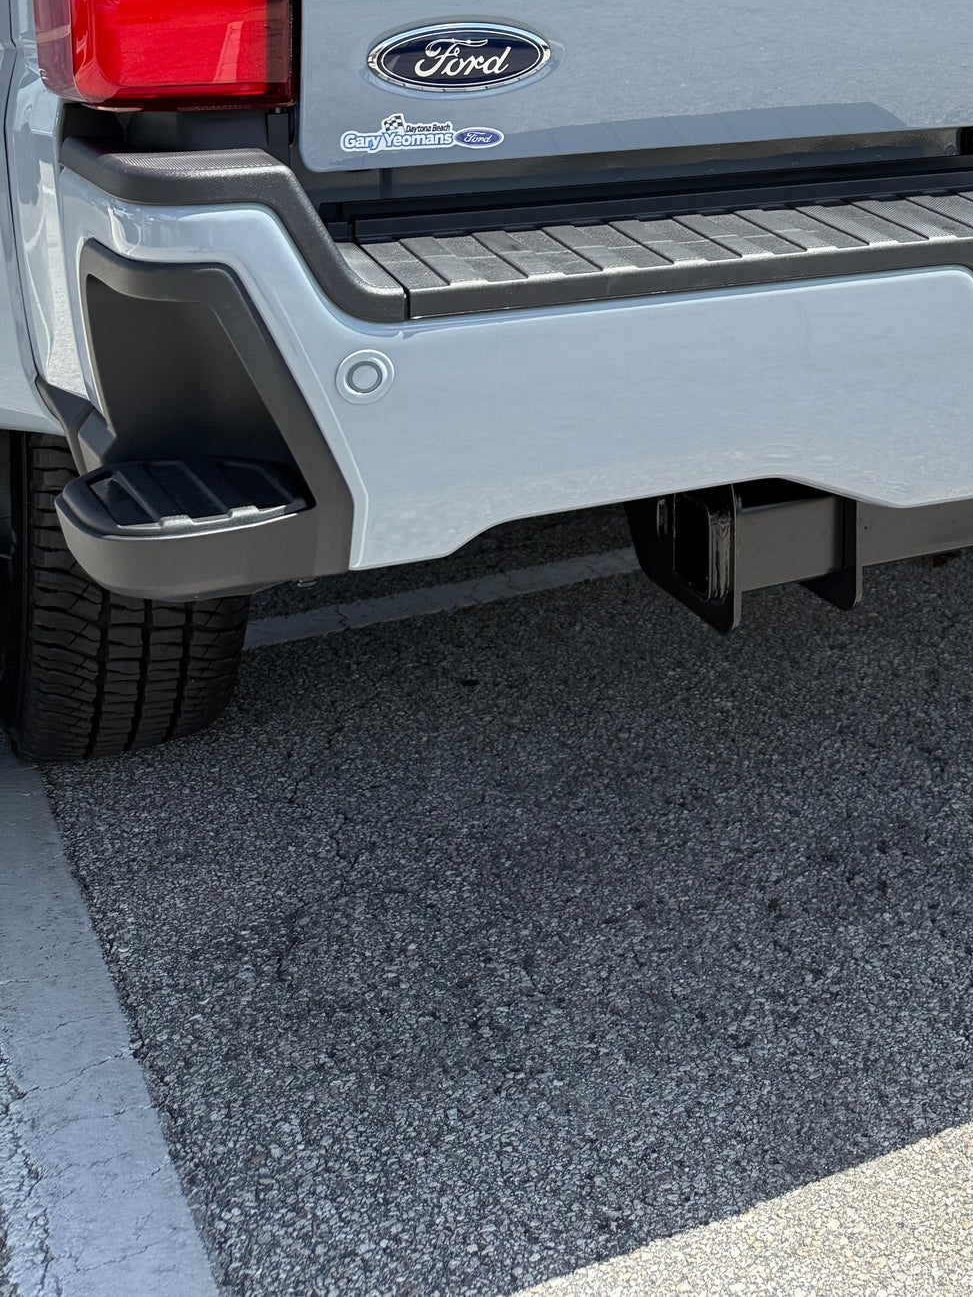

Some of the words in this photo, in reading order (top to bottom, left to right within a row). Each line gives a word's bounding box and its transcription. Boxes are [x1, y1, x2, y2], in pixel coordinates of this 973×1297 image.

[414, 37, 512, 78] Ford
[405, 124, 431, 134] Daytona
[432, 123, 451, 132] Beach
[344, 133, 382, 150] Gary
[382, 132, 454, 148] Yeomans
[463, 132, 492, 144] Ford
